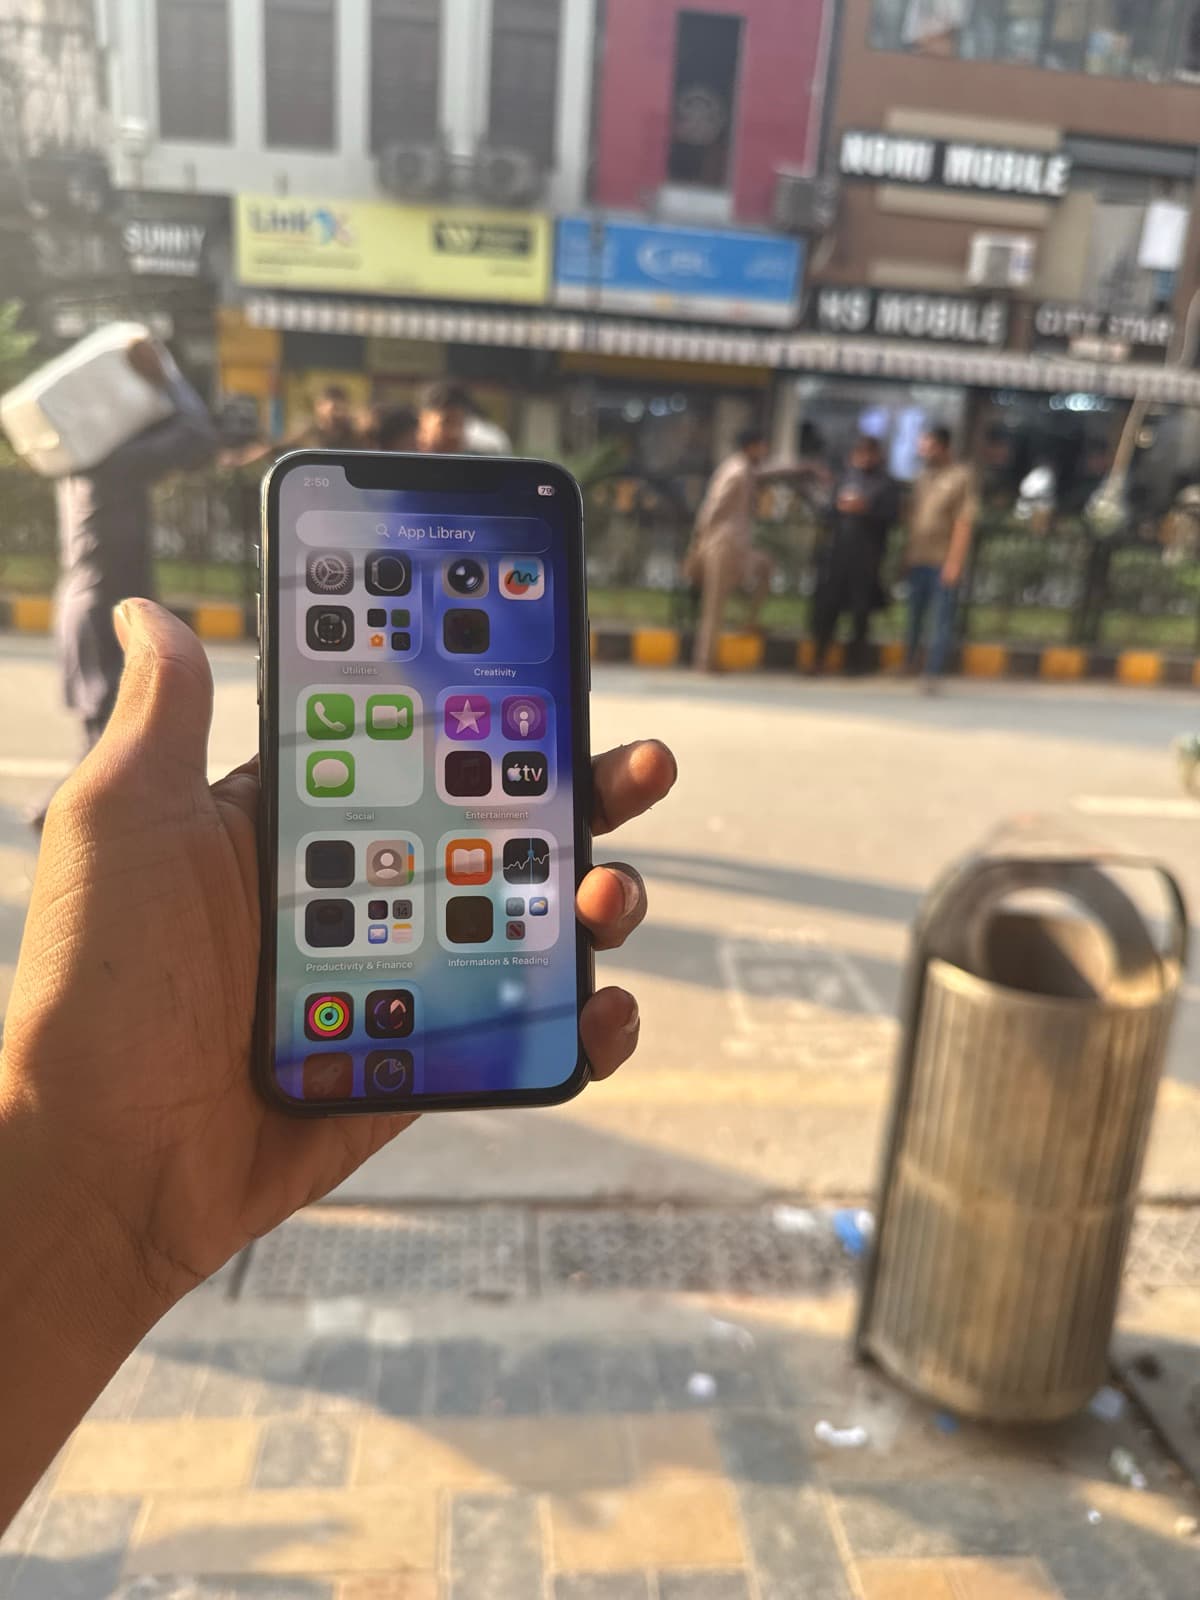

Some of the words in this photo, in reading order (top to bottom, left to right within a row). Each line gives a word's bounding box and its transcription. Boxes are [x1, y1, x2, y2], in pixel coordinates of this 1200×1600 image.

[942, 143, 1072, 196] MOBILE
[304, 478, 330, 488] 2:50
[398, 526, 425, 540] App
[429, 527, 476, 543] Library
[342, 666, 378, 675] Utilities
[474, 667, 517, 679] Creativity
[522, 764, 543, 782] tv
[346, 811, 375, 822] Social
[465, 811, 529, 821] Entertainment
[306, 961, 364, 973] Productivity
[366, 961, 374, 969] &
[376, 960, 413, 970] Finance
[448, 958, 501, 968] Information
[502, 957, 510, 966] &
[512, 956, 549, 968] Reading
